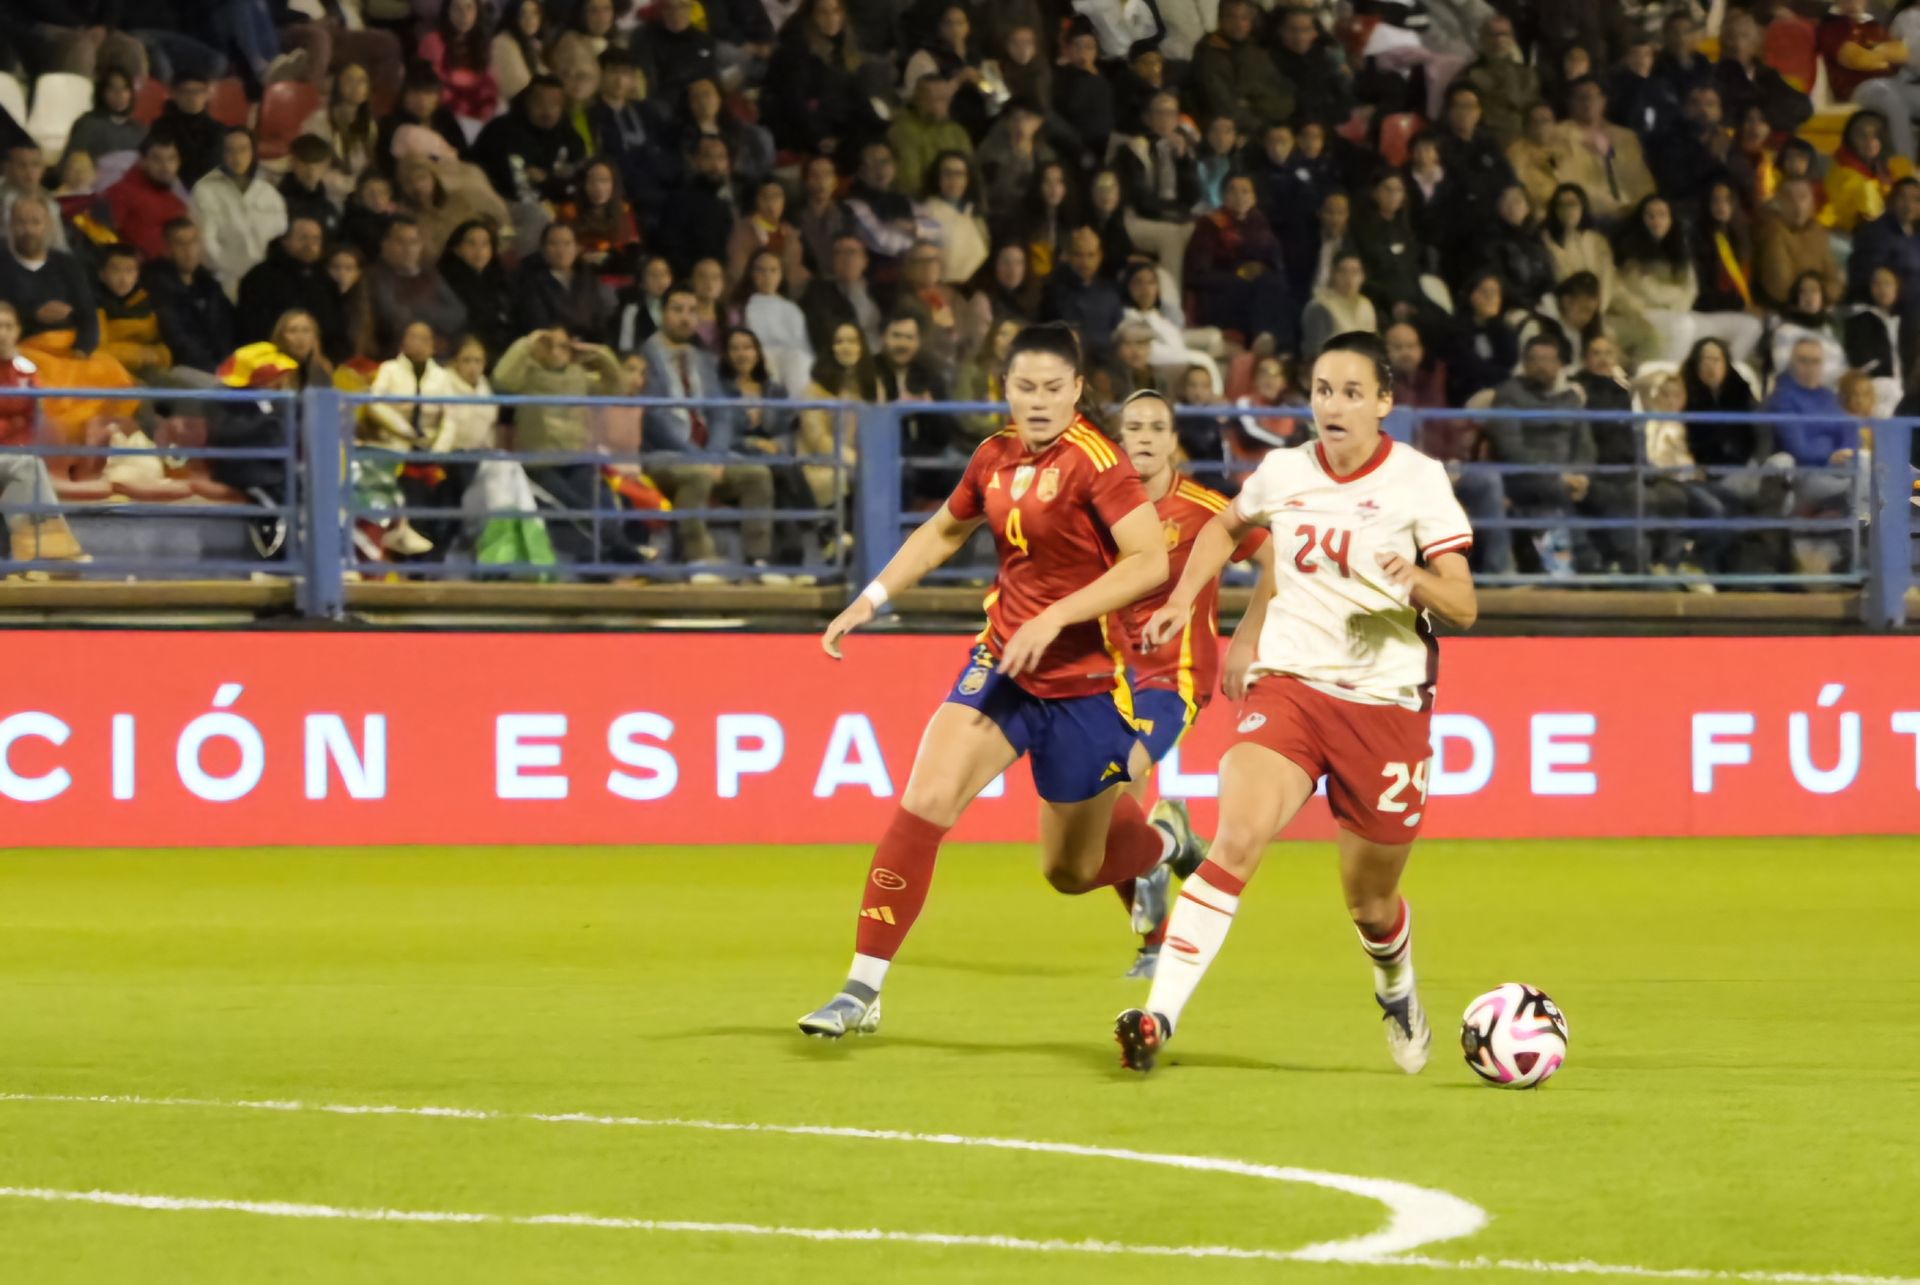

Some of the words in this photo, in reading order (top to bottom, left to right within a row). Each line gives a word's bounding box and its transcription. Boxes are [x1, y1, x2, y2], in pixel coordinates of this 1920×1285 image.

[1005, 508, 1028, 556] 4
[1294, 524, 1351, 578] 24
[0, 684, 387, 802] CIÓN
[496, 712, 1327, 800] ESPAL
[1427, 712, 1597, 796] DE
[1377, 757, 1431, 813] 24
